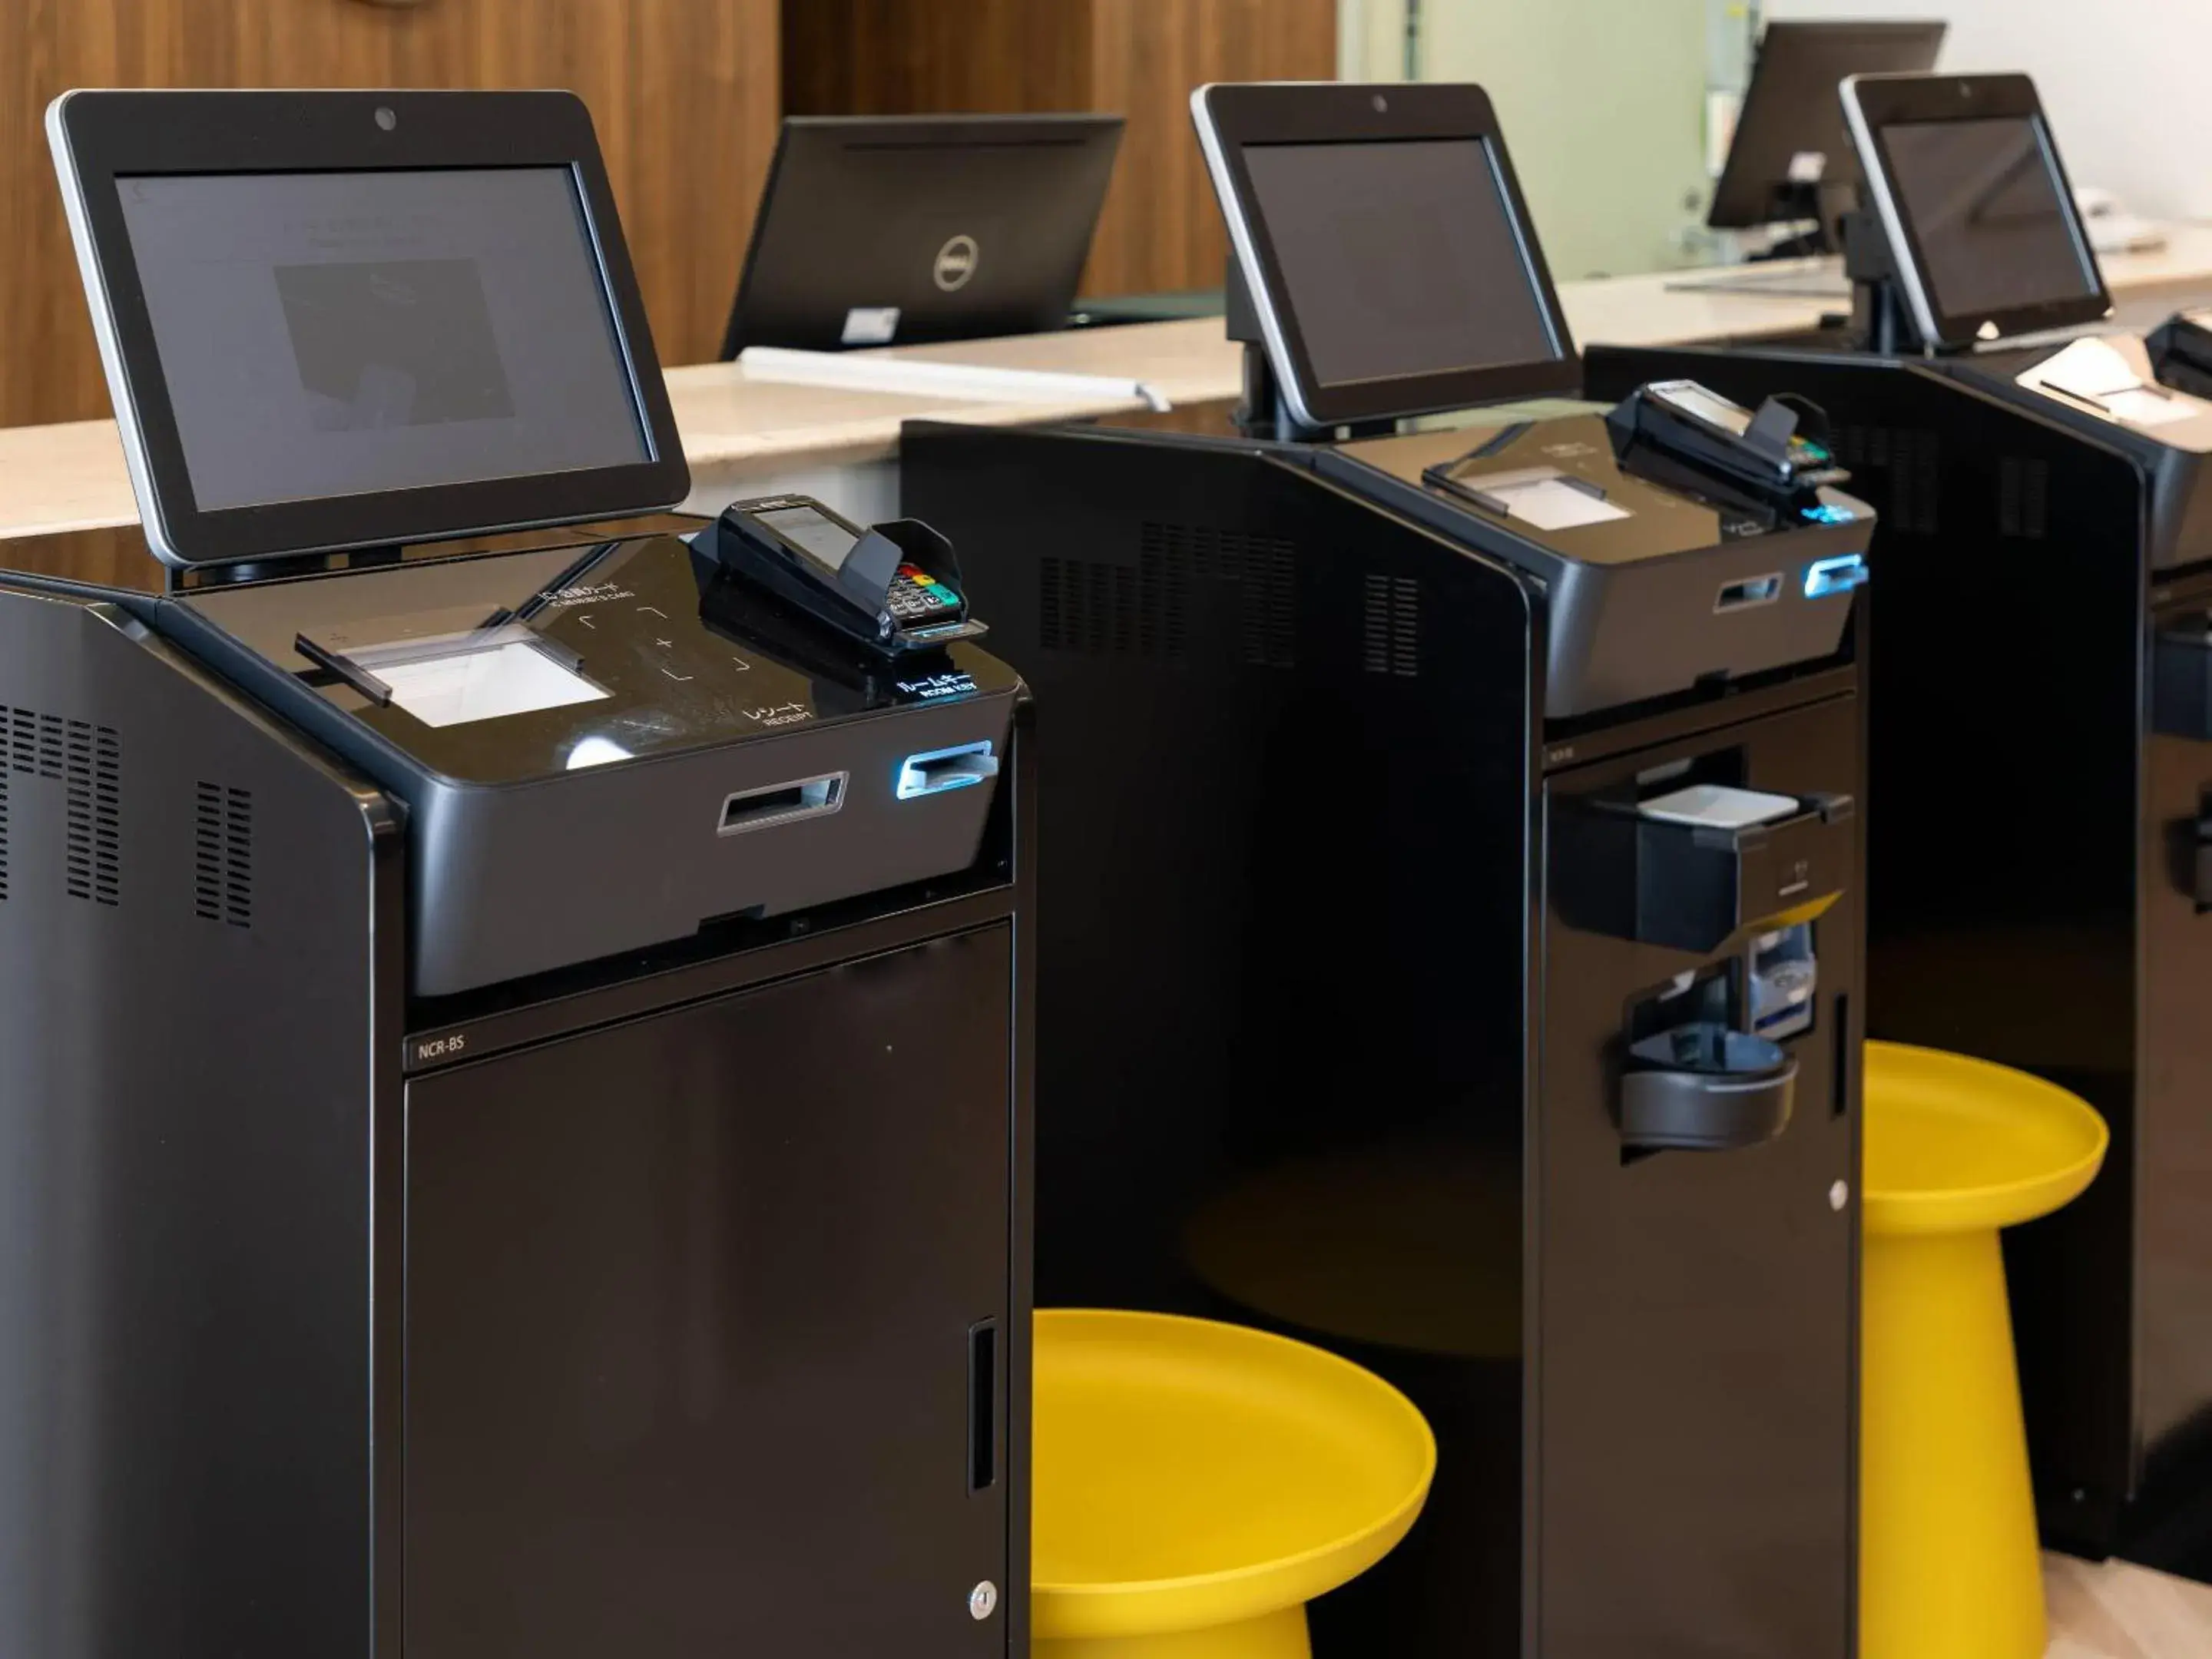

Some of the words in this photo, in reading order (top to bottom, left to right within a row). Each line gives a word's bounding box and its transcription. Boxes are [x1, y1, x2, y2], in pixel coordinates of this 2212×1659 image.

[896, 674, 972, 692] ルームキー
[742, 702, 804, 720] レシート
[763, 711, 813, 726] RECEIPT
[419, 1035, 464, 1059] NCR-BS
